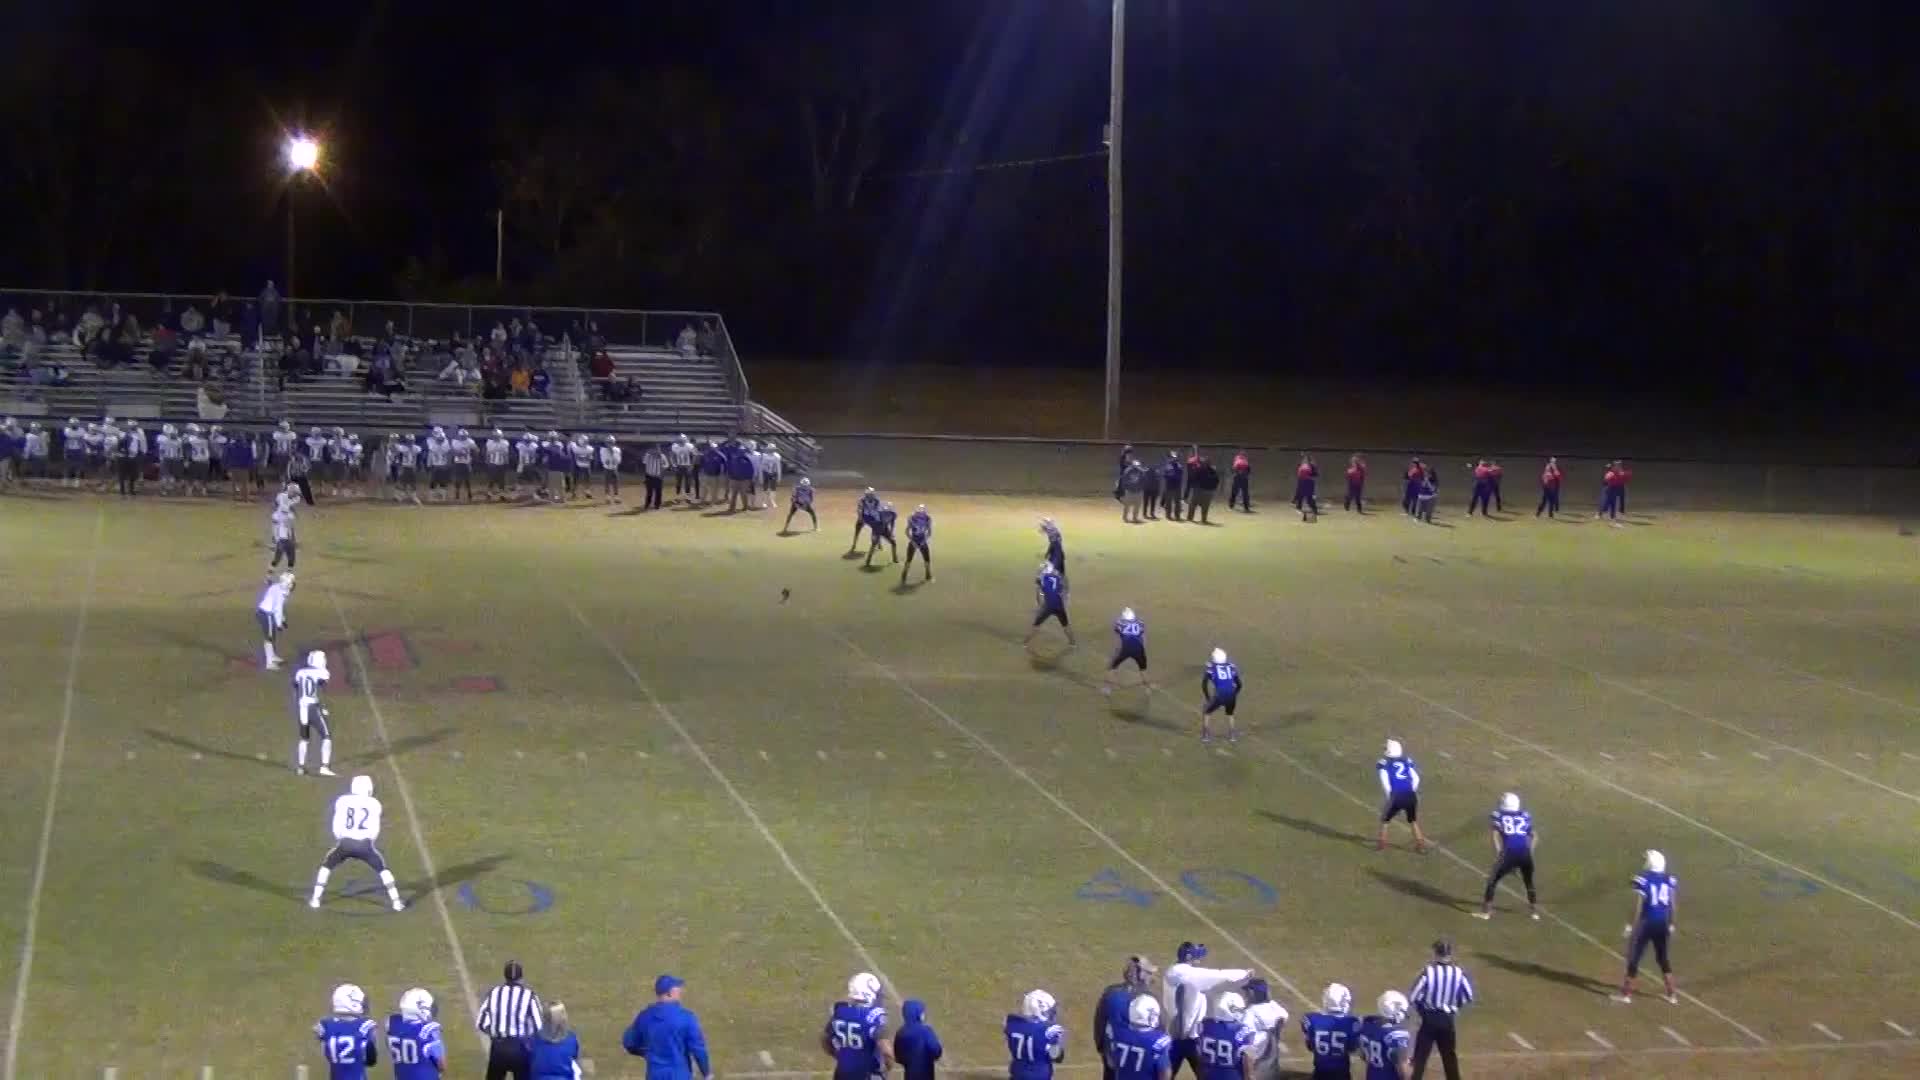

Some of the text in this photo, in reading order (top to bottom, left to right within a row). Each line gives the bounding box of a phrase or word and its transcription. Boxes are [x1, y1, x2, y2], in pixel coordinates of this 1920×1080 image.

[1215, 664, 1233, 681] 61
[1392, 760, 1408, 780] 2
[345, 806, 370, 830] 82
[1501, 815, 1528, 836] 82
[1650, 882, 1670, 906] 14
[831, 1019, 864, 1050] 56
[1010, 1032, 1035, 1061] 71
[329, 1035, 356, 1064] 12
[388, 1036, 419, 1064] 50
[1116, 1042, 1146, 1072] 77
[1202, 1036, 1234, 1066] 59
